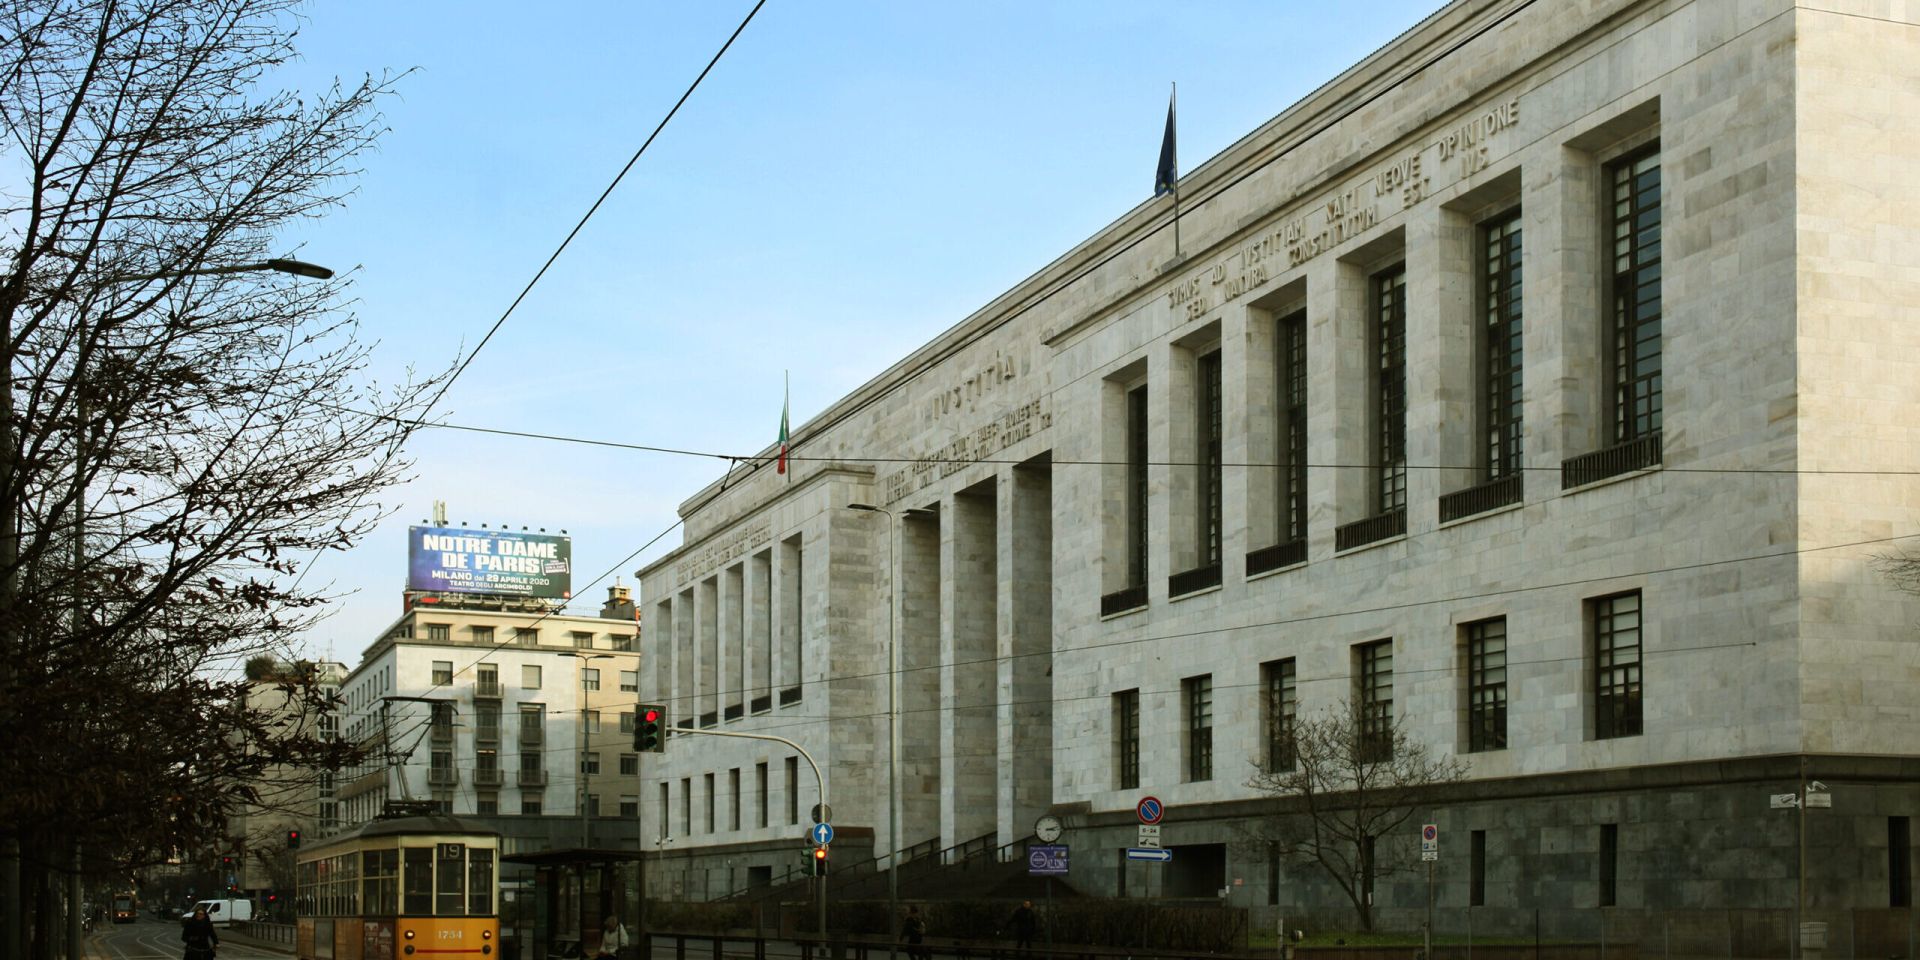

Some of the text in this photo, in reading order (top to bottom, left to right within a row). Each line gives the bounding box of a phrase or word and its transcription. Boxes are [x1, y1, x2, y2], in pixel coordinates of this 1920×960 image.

[1403, 177, 1431, 209] EST
[1460, 147, 1489, 180] IVS
[1211, 264, 1226, 286] AD
[1439, 99, 1519, 162] OPINIONE
[423, 534, 492, 554] NOTRE
[498, 540, 557, 559] DAME
[442, 552, 468, 568] DE
[475, 555, 540, 573] PARIS
[432, 570, 472, 581] MILANO
[500, 576, 528, 585] APRILE
[529, 577, 550, 586] 2020
[443, 844, 460, 858] 19
